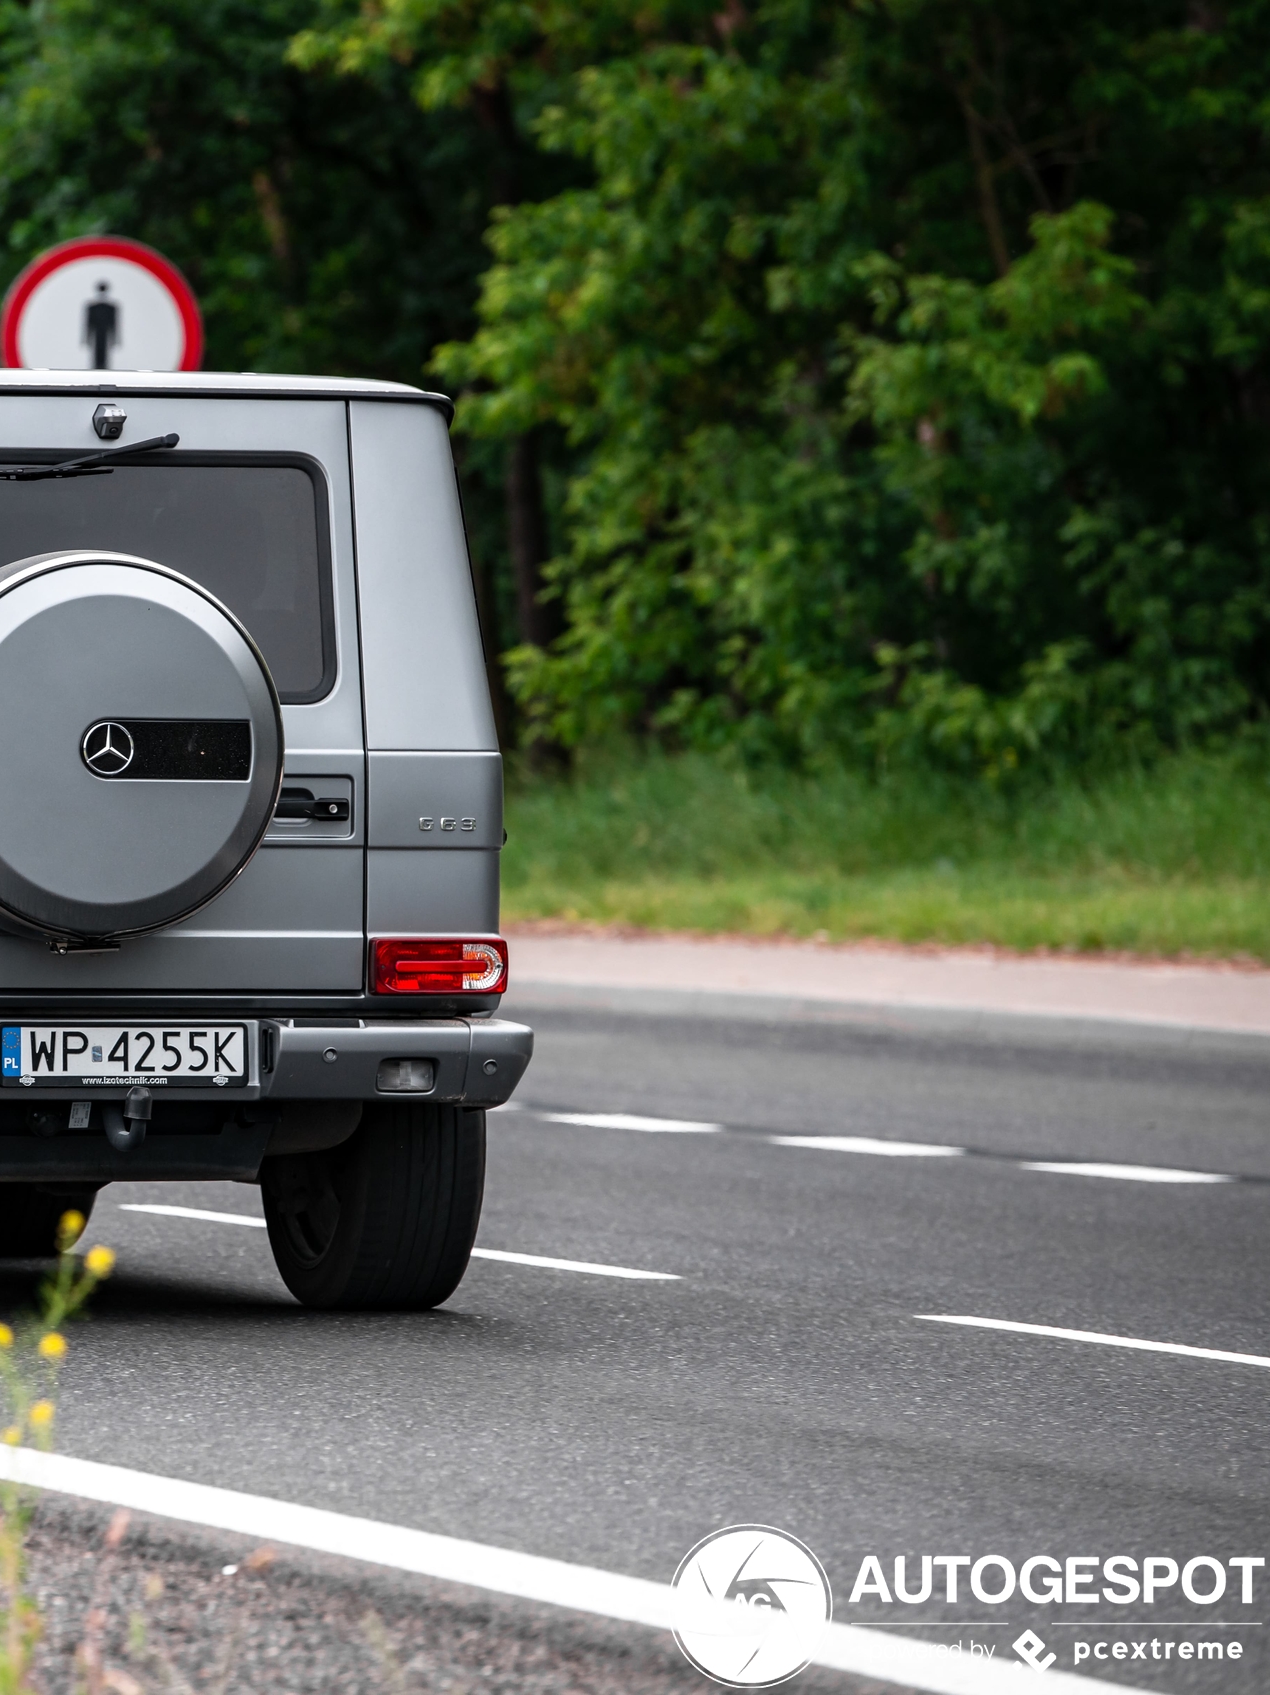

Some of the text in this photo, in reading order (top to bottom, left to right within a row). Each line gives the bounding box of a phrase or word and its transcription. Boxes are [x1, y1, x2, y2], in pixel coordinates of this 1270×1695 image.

[30, 1031, 237, 1072] WP 4255K
[4, 1057, 19, 1069] PL
[81, 1076, 168, 1085] www.izotechnik.com
